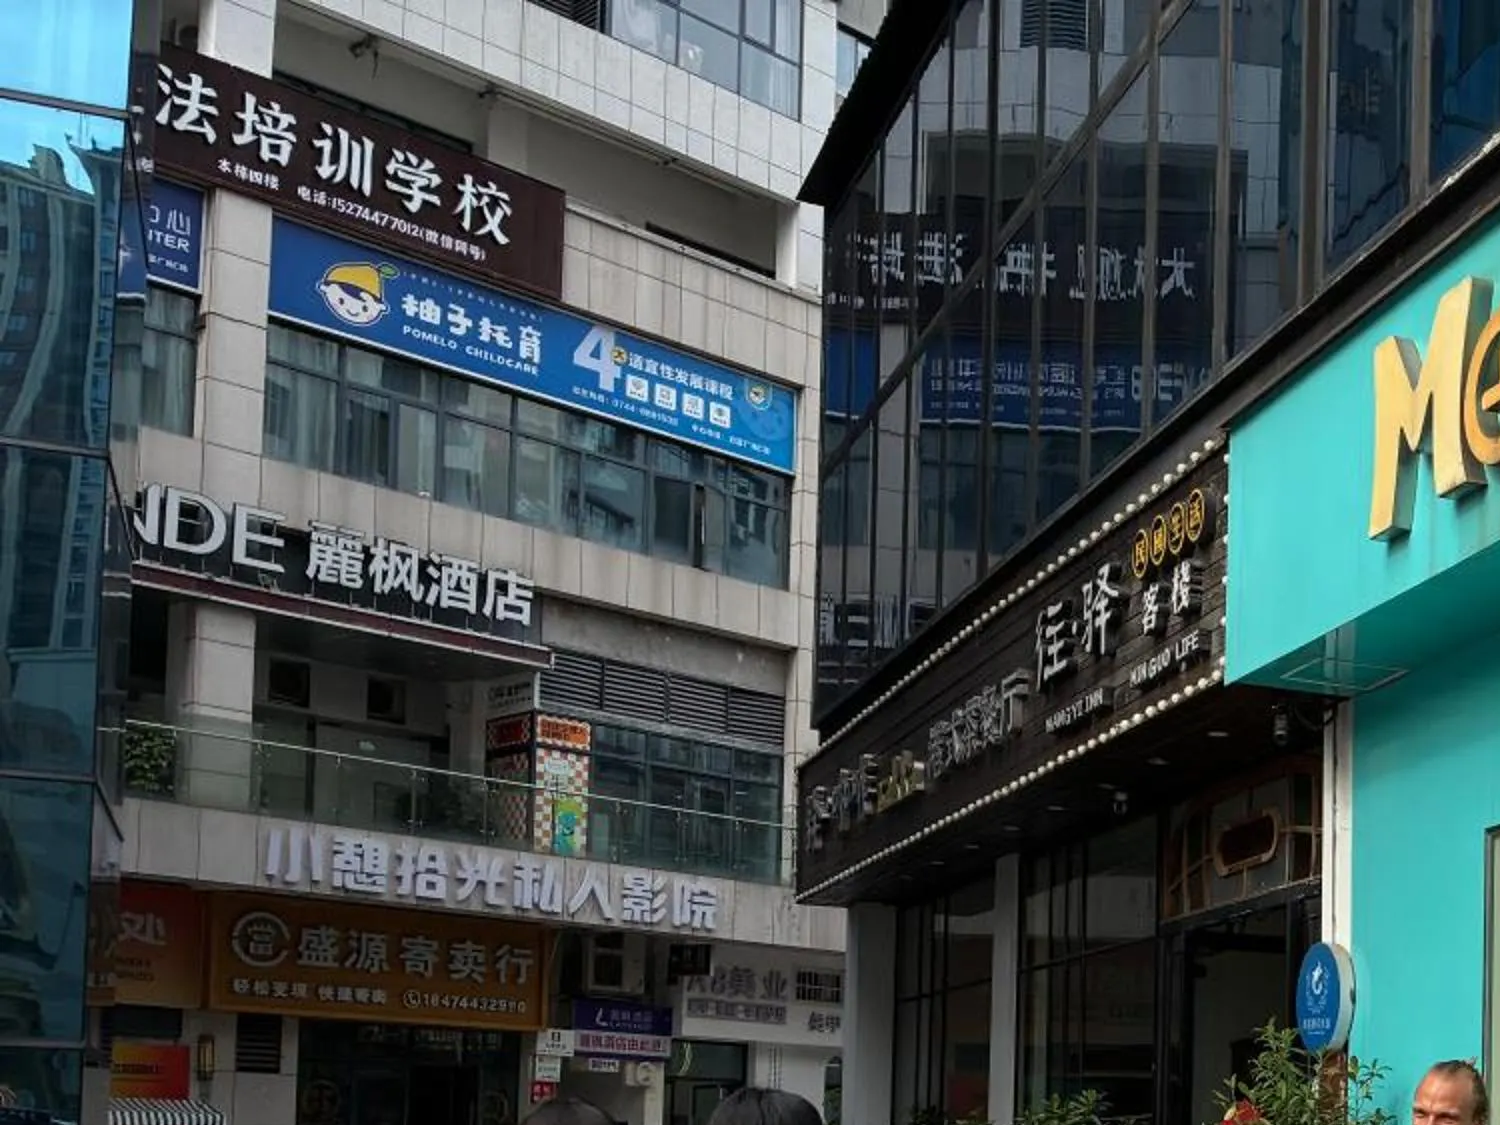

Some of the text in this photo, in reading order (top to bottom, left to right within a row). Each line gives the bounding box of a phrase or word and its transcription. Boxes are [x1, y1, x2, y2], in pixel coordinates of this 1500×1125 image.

[155, 63, 512, 245] 法培训学校
[402, 293, 541, 365] 柚子托育
[403, 324, 540, 376] POMELO CHILDCARE
[264, 826, 718, 932] 小憩拾光私人影院
[298, 923, 534, 986] 盛源寄卖行
